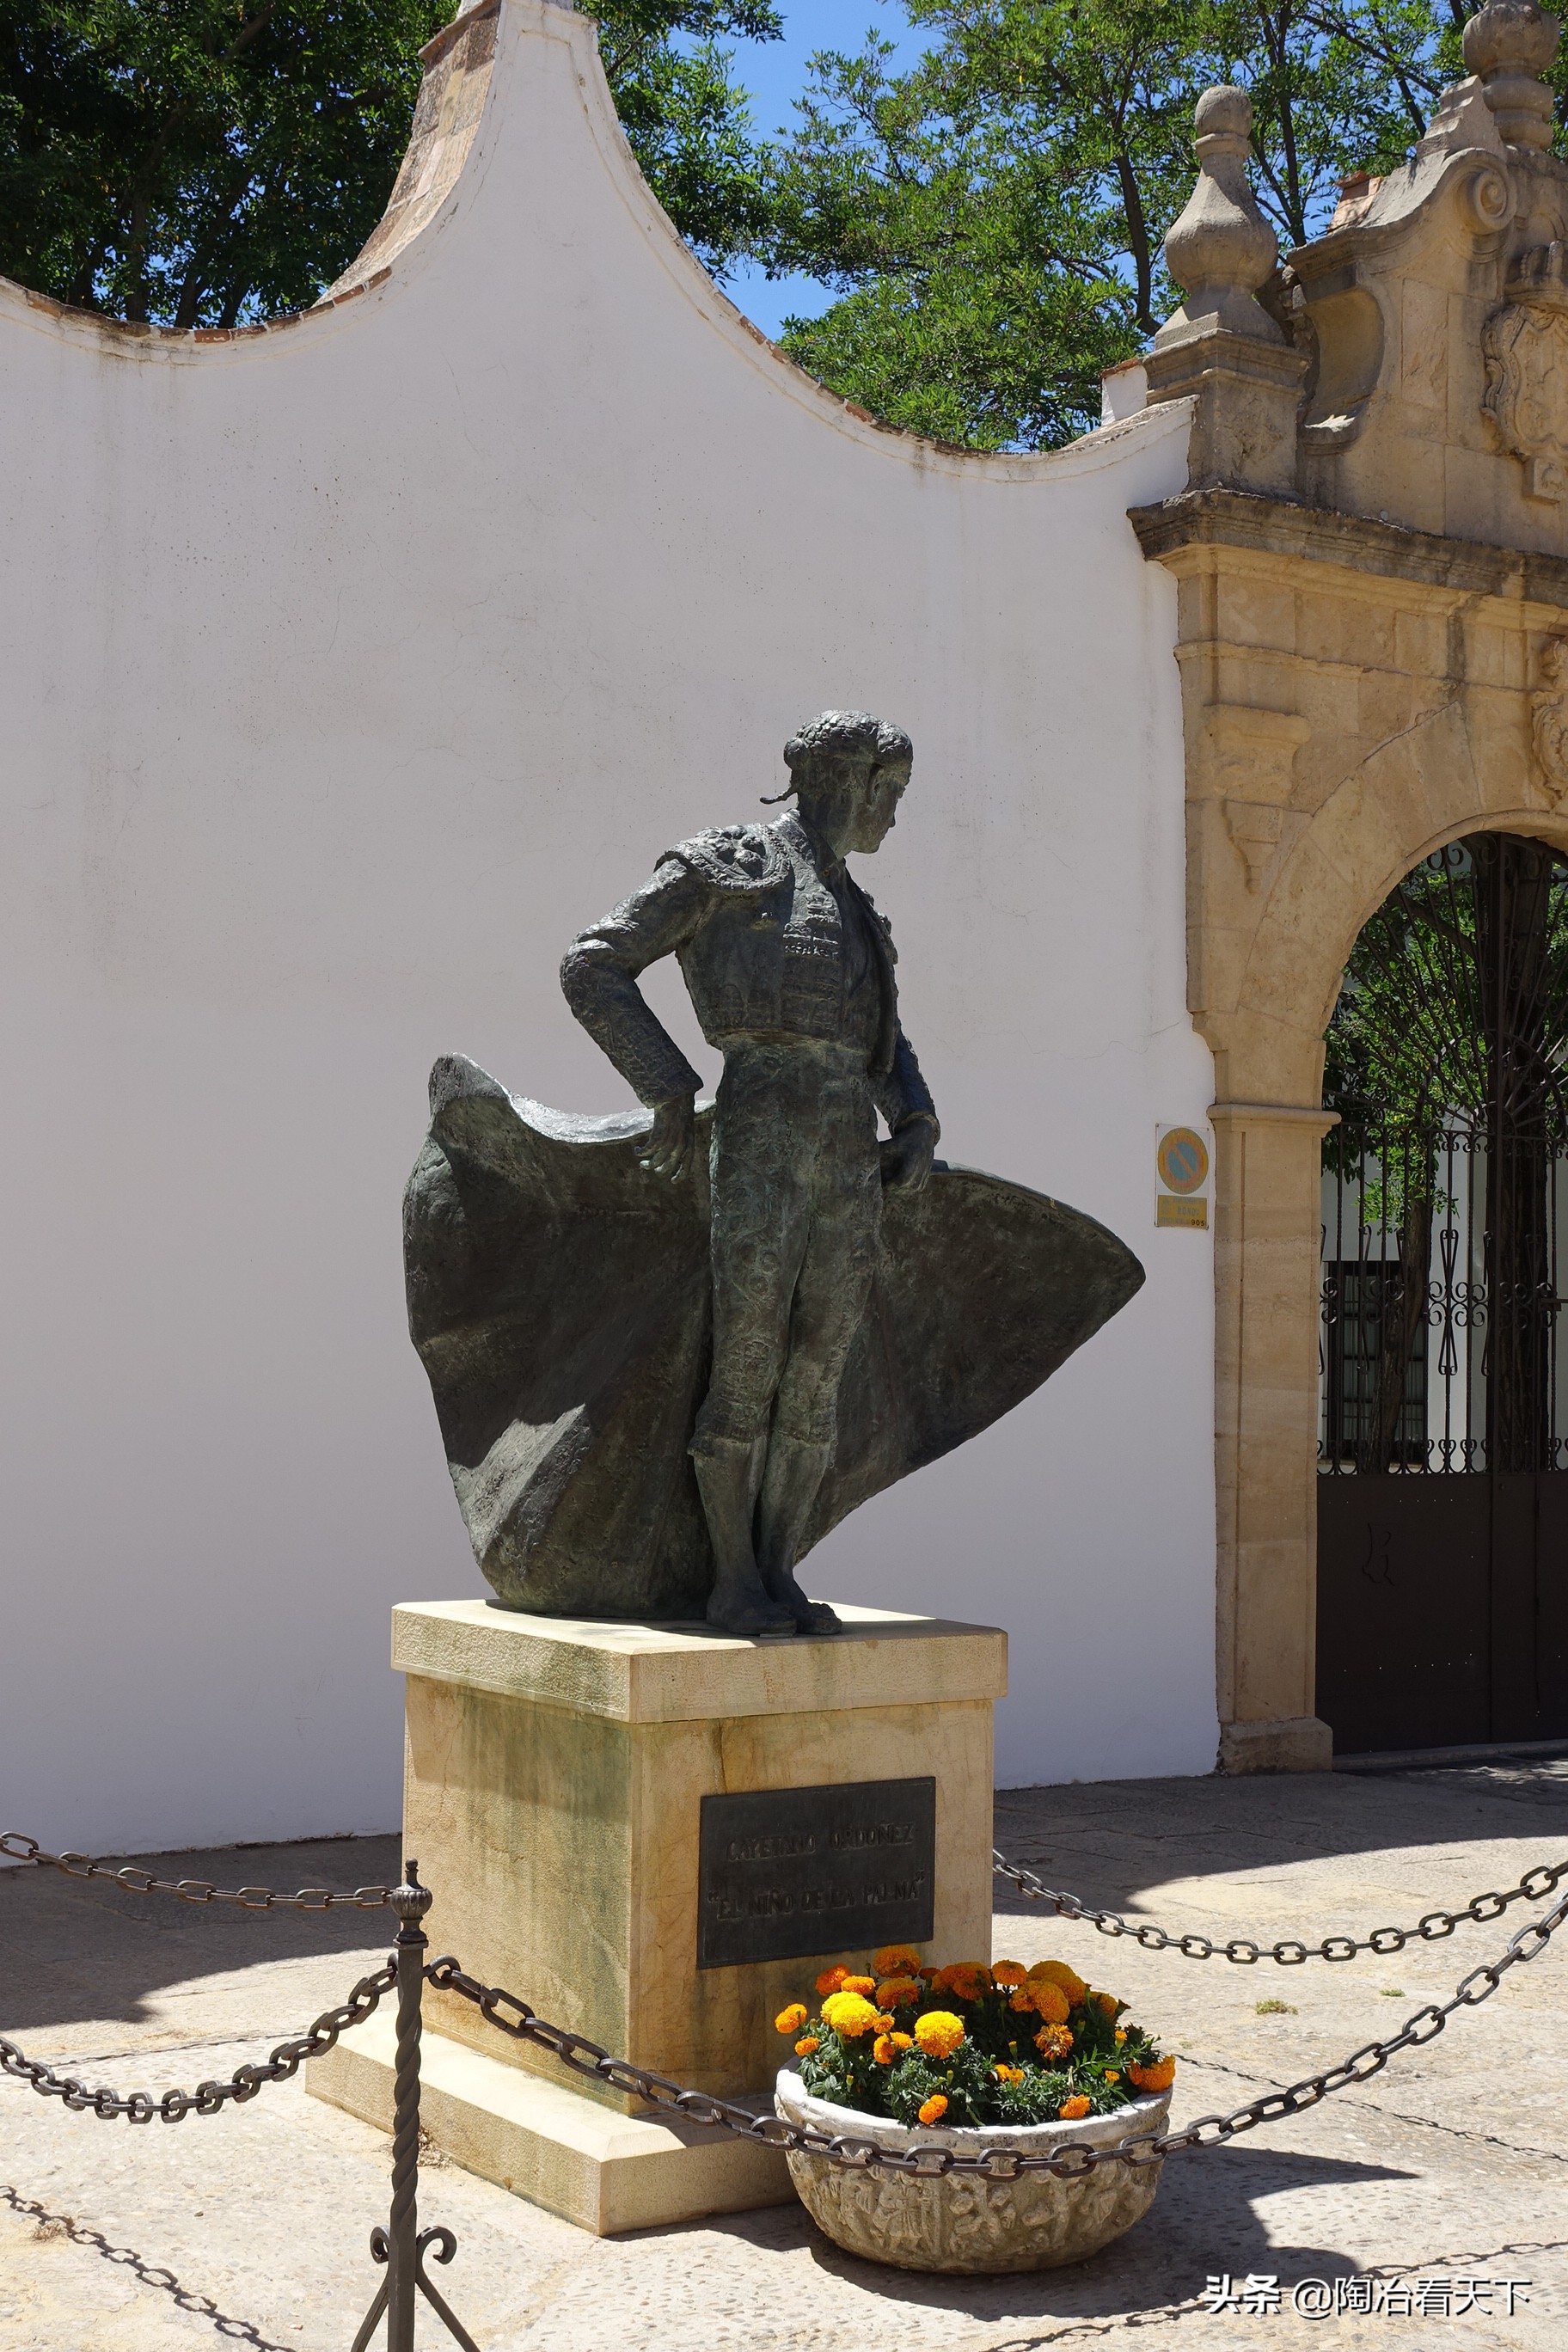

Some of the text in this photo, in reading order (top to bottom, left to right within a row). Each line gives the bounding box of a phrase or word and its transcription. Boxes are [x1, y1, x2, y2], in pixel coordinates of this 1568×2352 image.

[726, 1834, 816, 1862] CAYETANO
[801, 1890, 826, 1914] DE
[830, 1885, 857, 1909] LA
